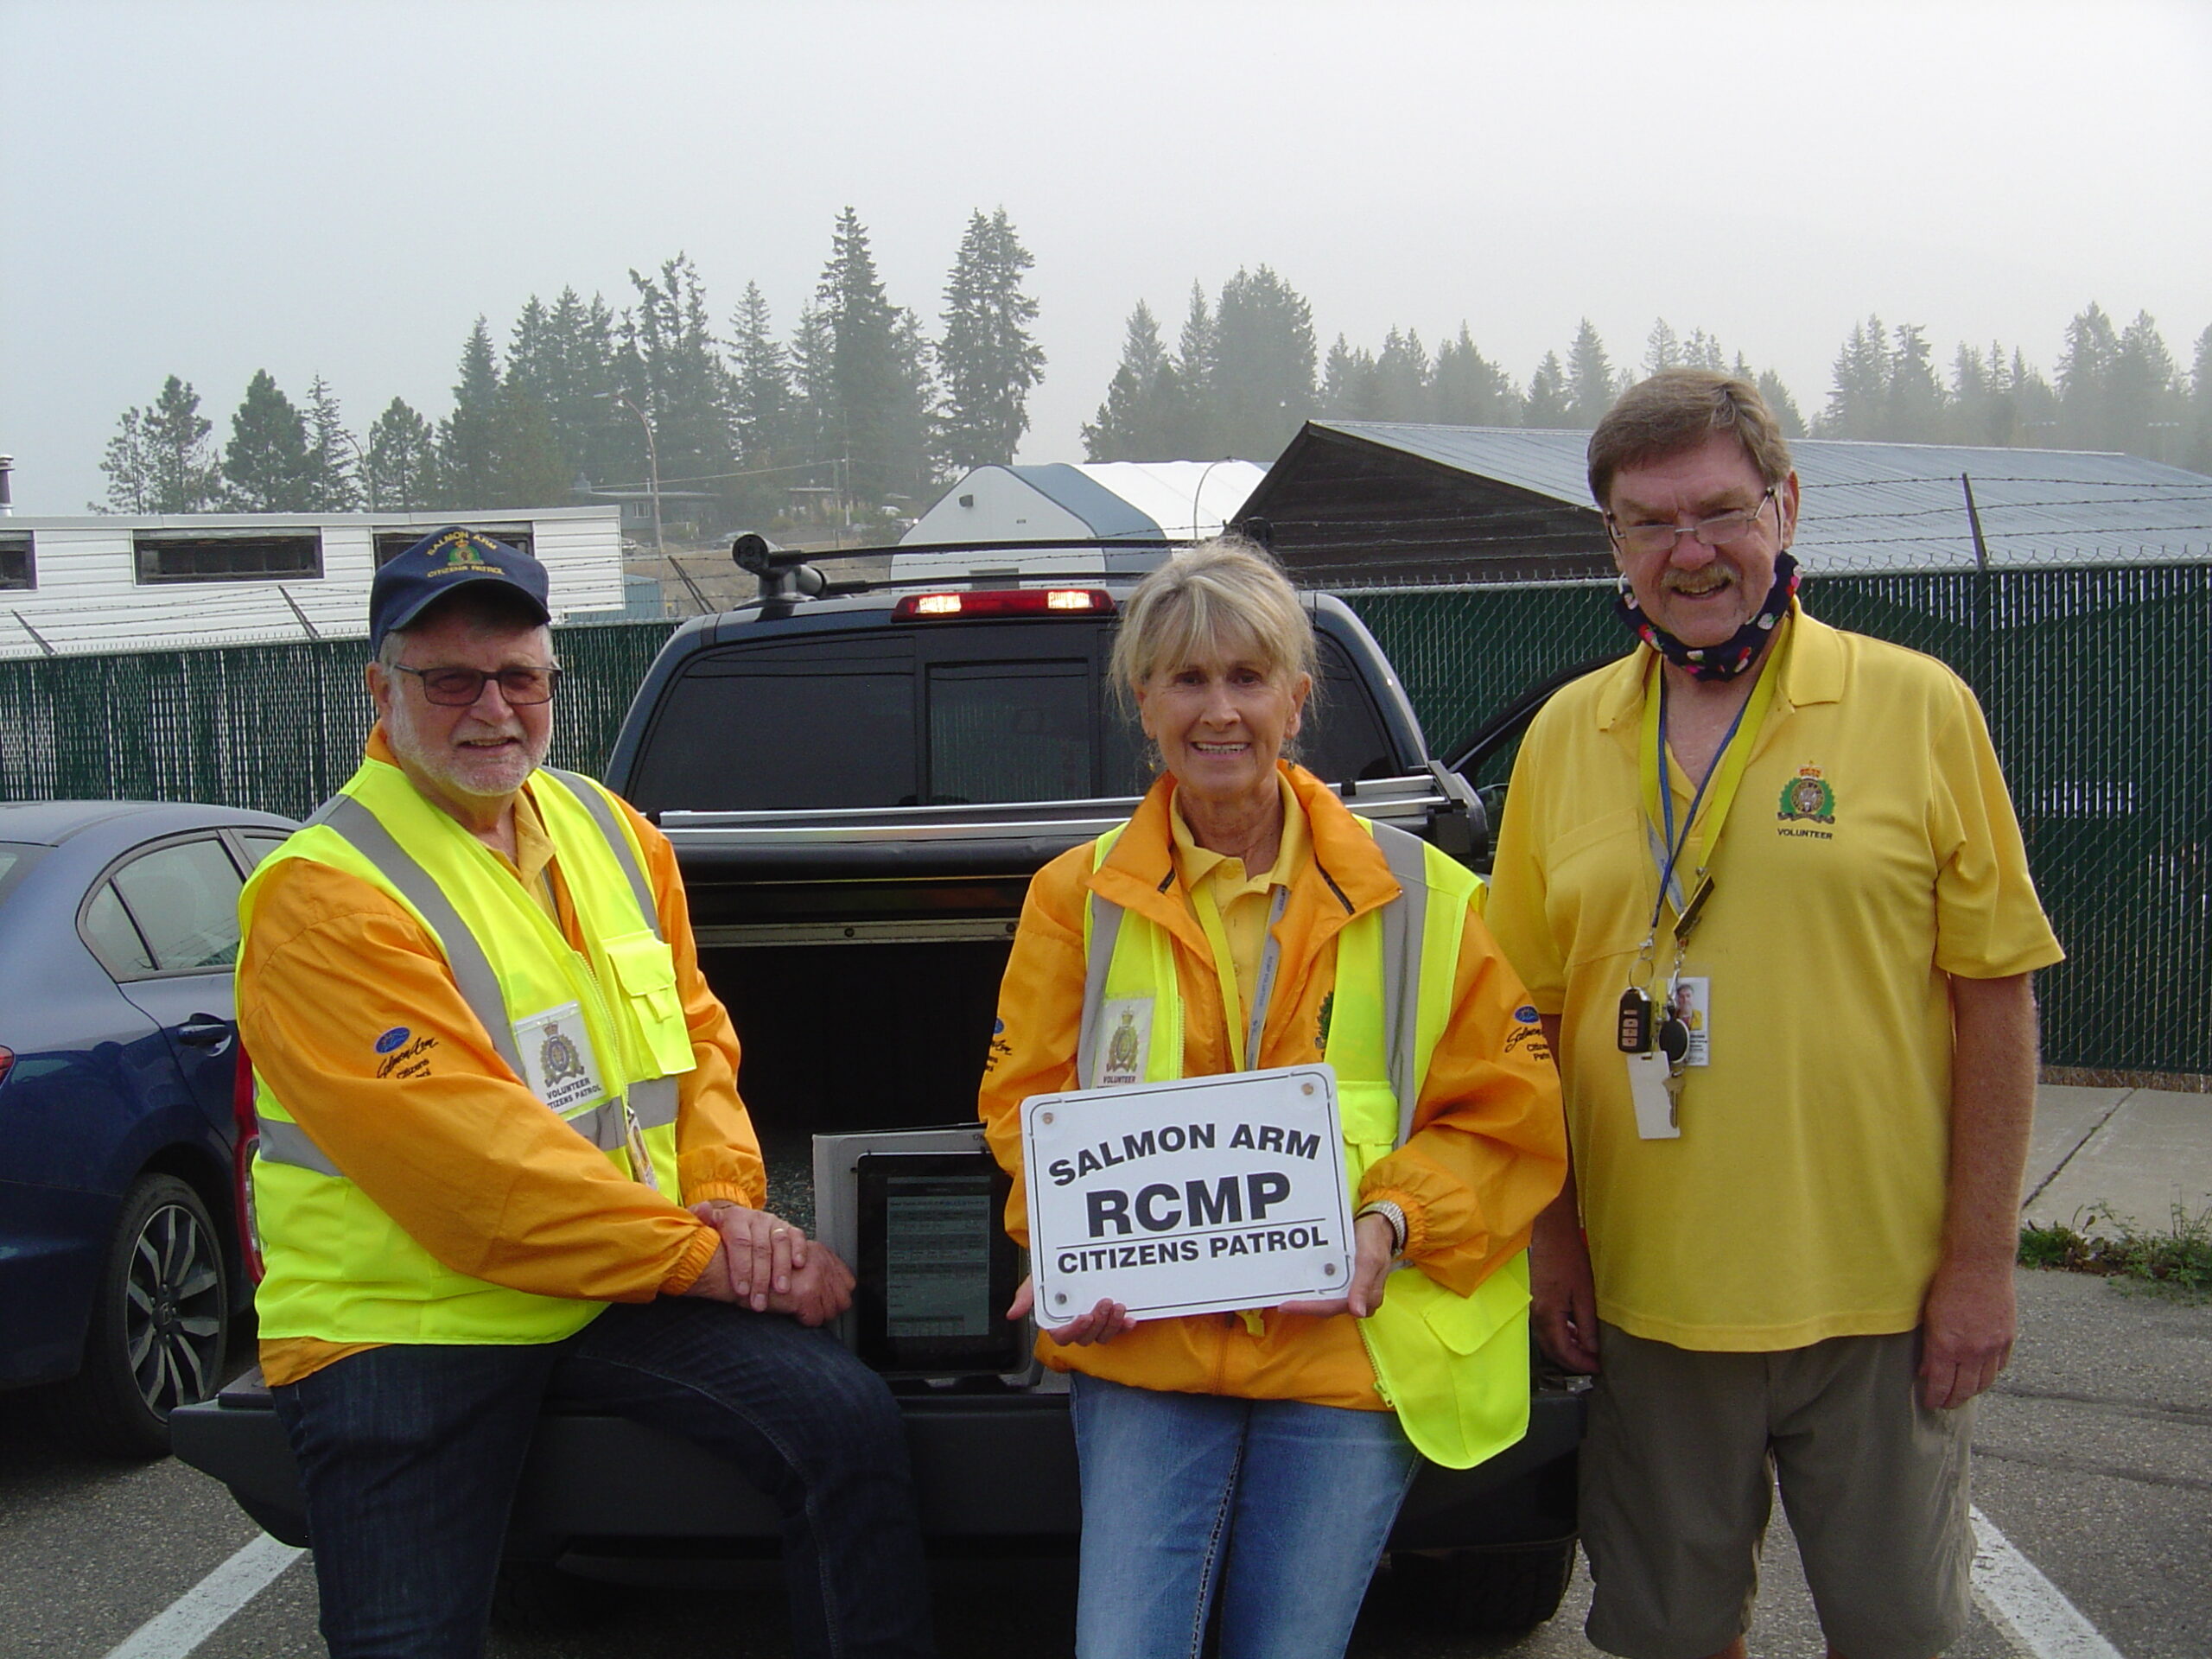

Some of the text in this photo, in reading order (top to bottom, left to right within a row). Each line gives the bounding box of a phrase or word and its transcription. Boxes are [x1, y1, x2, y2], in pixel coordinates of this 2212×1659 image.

[427, 531, 498, 556] SALMON ARM
[427, 565, 505, 578] CITIZENS PATROL
[1777, 828, 1833, 840] VOLUNTEER
[547, 1077, 590, 1099] VOLUNTEER
[1103, 1075, 1136, 1084] VOLUNTEER
[575, 1084, 601, 1098] PATROL
[1049, 1123, 1321, 1185] SALMON ARM
[1086, 1172, 1291, 1238] RCMP
[1058, 1227, 1328, 1274] CITIZENS PATROL
